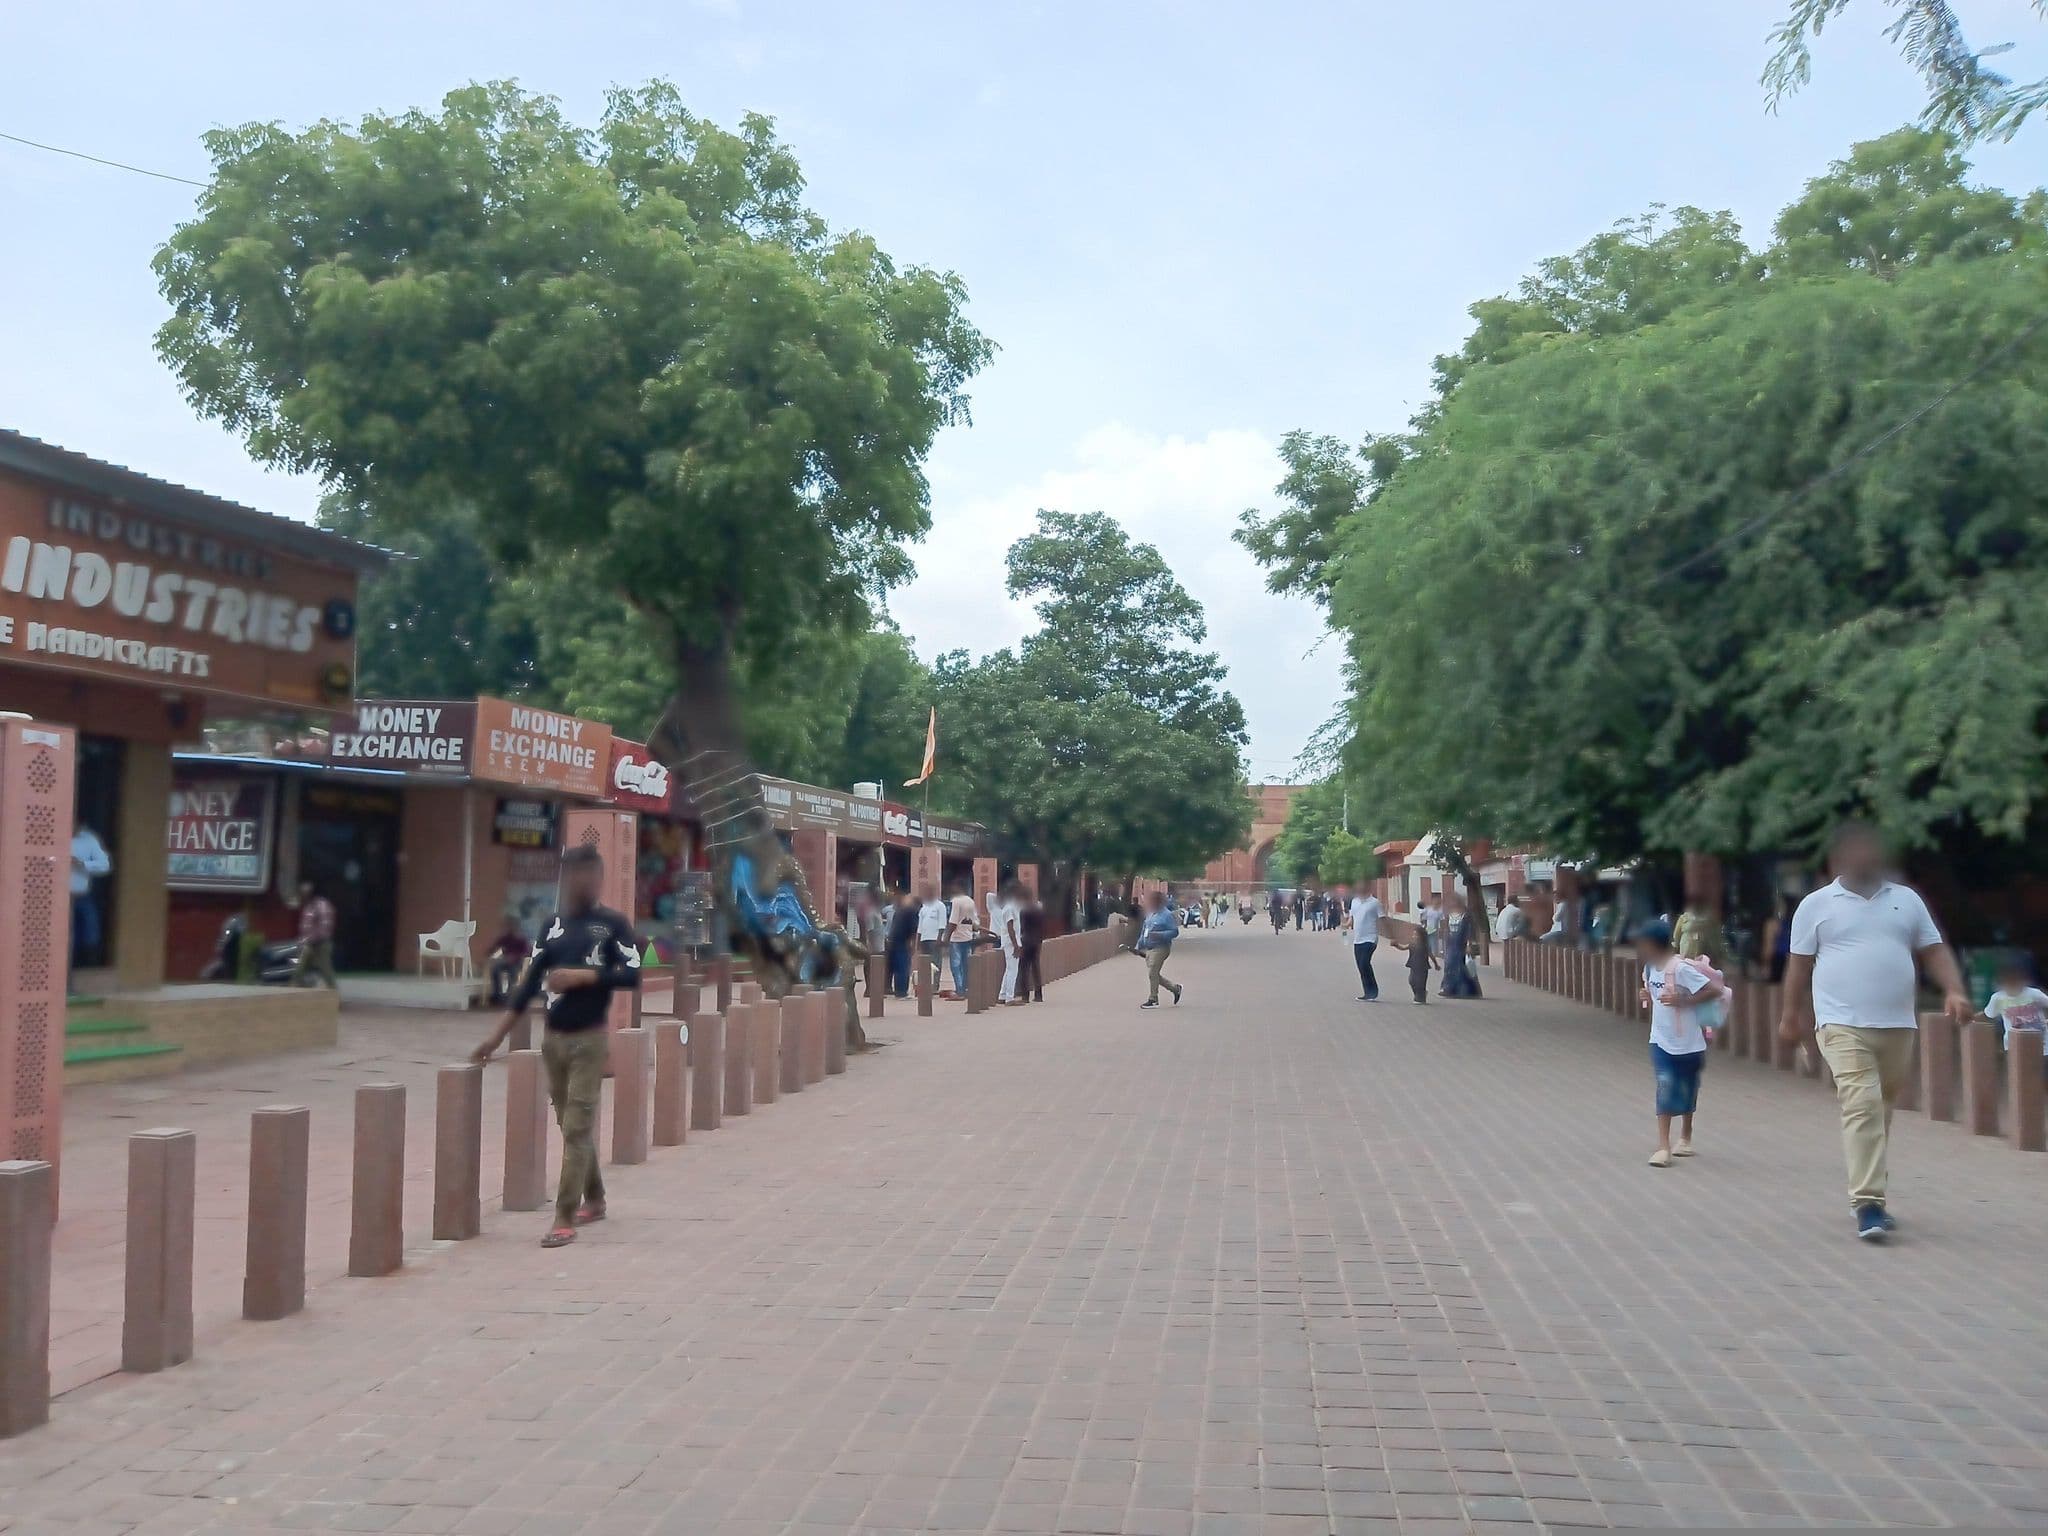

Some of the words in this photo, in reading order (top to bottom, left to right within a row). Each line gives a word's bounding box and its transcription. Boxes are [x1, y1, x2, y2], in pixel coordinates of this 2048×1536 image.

[50, 497, 272, 580] INDUSTRI
[1, 535, 322, 653] INDUSTRIES
[27, 621, 210, 677] HANDICRAFTS
[358, 706, 441, 734] MONEY
[511, 707, 584, 742] MONEY
[331, 733, 464, 761] EXCHANGE
[490, 729, 596, 769] EXCHANGE
